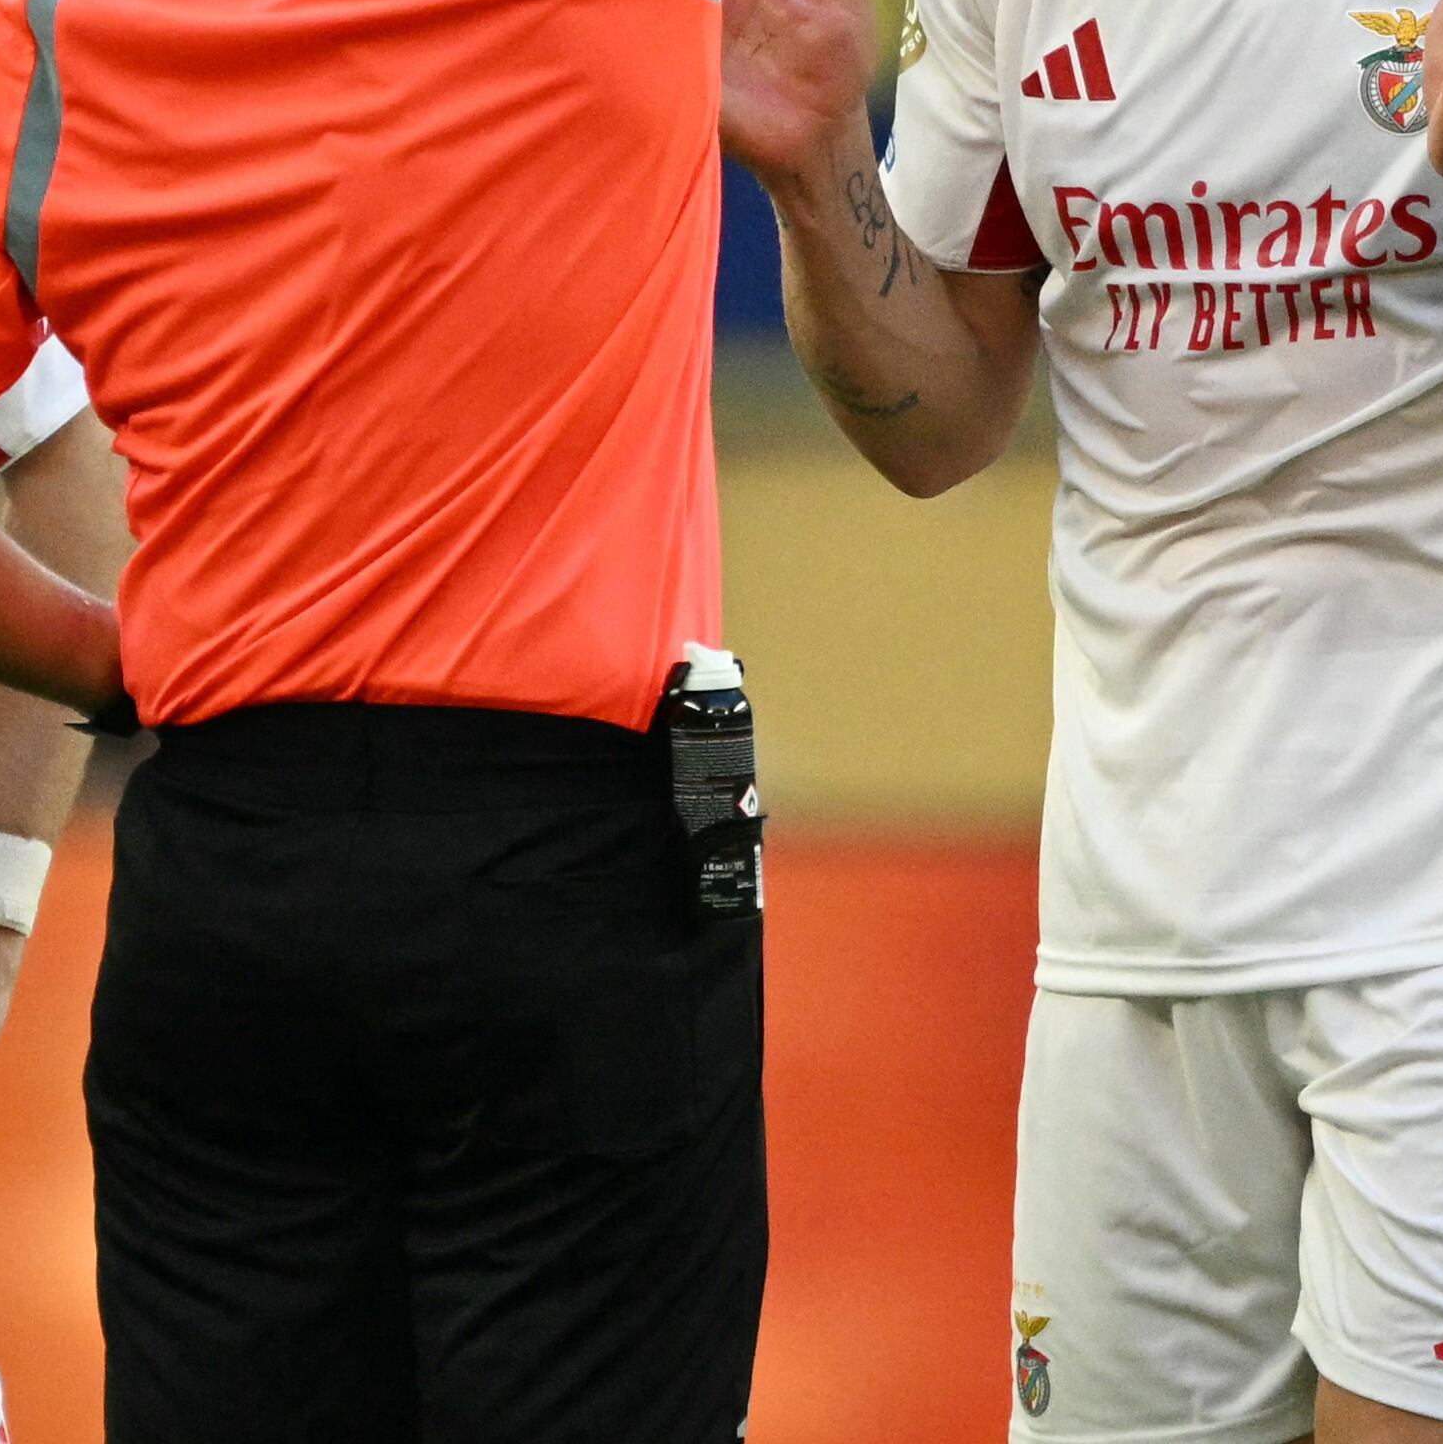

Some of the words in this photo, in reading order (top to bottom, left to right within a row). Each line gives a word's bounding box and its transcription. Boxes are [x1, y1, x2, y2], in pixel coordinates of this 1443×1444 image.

[1052, 180, 1438, 272] Emirates
[1103, 282, 1171, 351] FLY
[1187, 274, 1376, 352] BETTER
